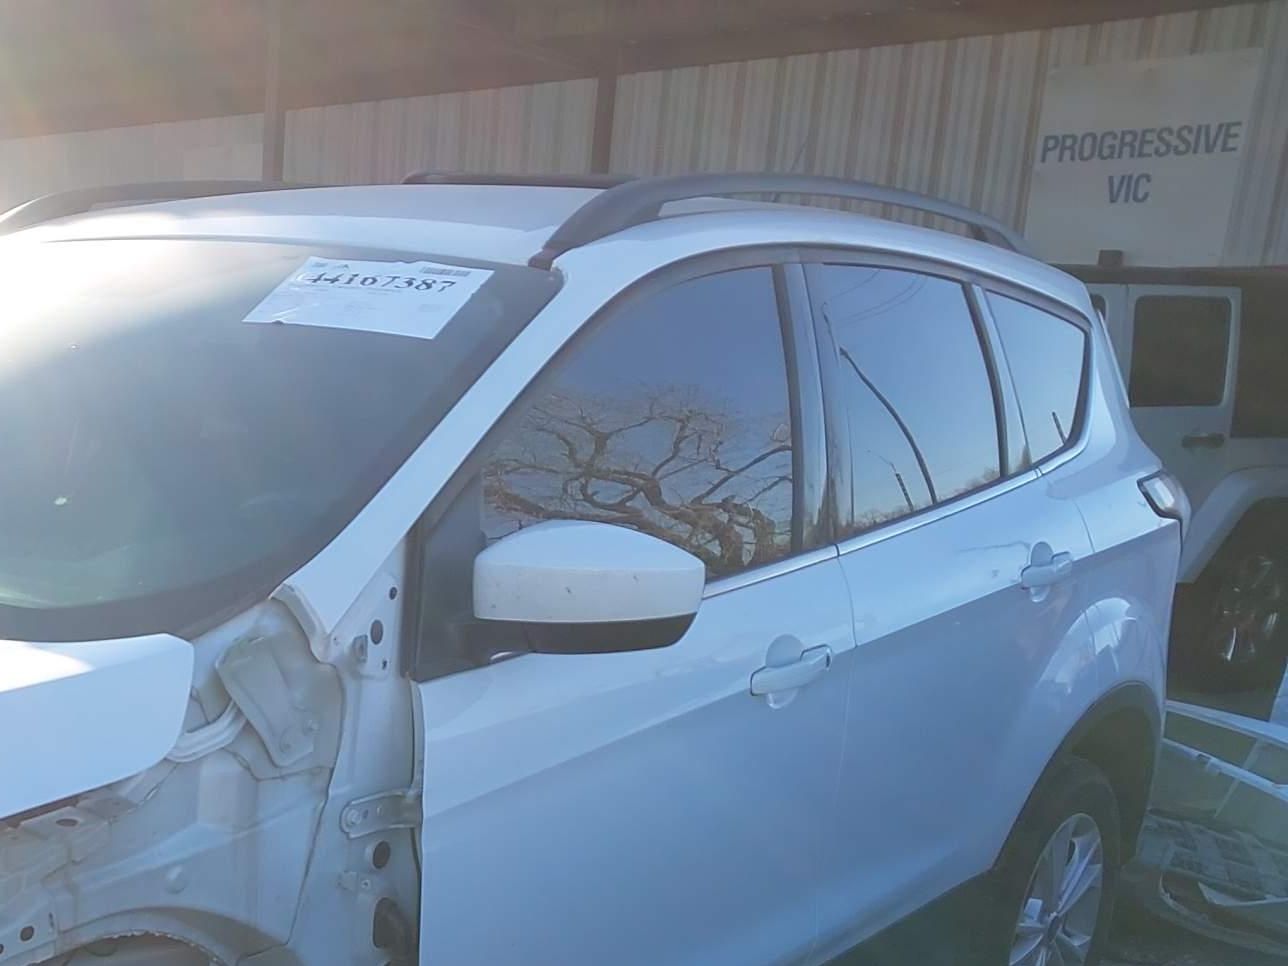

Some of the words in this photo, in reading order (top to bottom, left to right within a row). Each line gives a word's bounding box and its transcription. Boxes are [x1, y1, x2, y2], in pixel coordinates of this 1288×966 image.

[1040, 121, 1243, 164] PROGRESSIVE
[1107, 173, 1152, 204] VIC
[306, 271, 457, 294] 44167387
